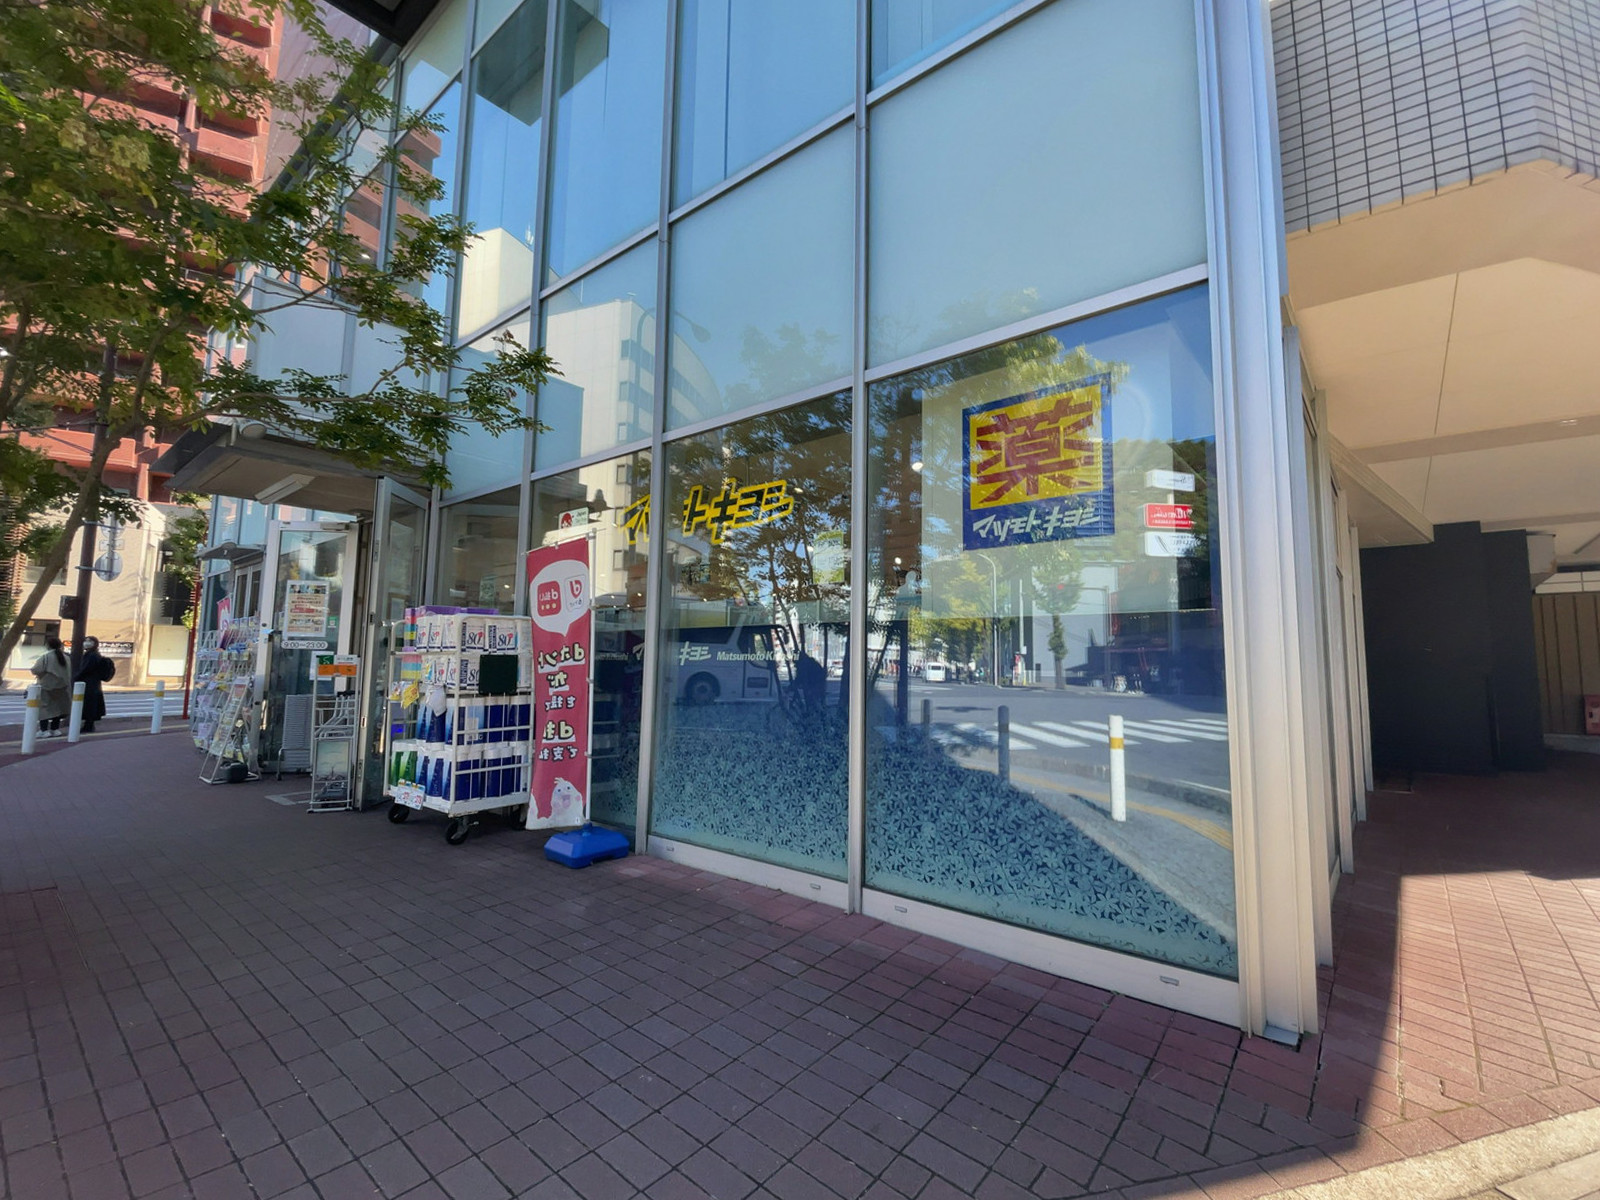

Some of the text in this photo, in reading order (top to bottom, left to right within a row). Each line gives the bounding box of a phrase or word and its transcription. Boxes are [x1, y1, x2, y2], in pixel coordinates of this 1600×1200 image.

[976, 395, 1093, 504] 薬
[972, 506, 1101, 541] マツモトキヨシ
